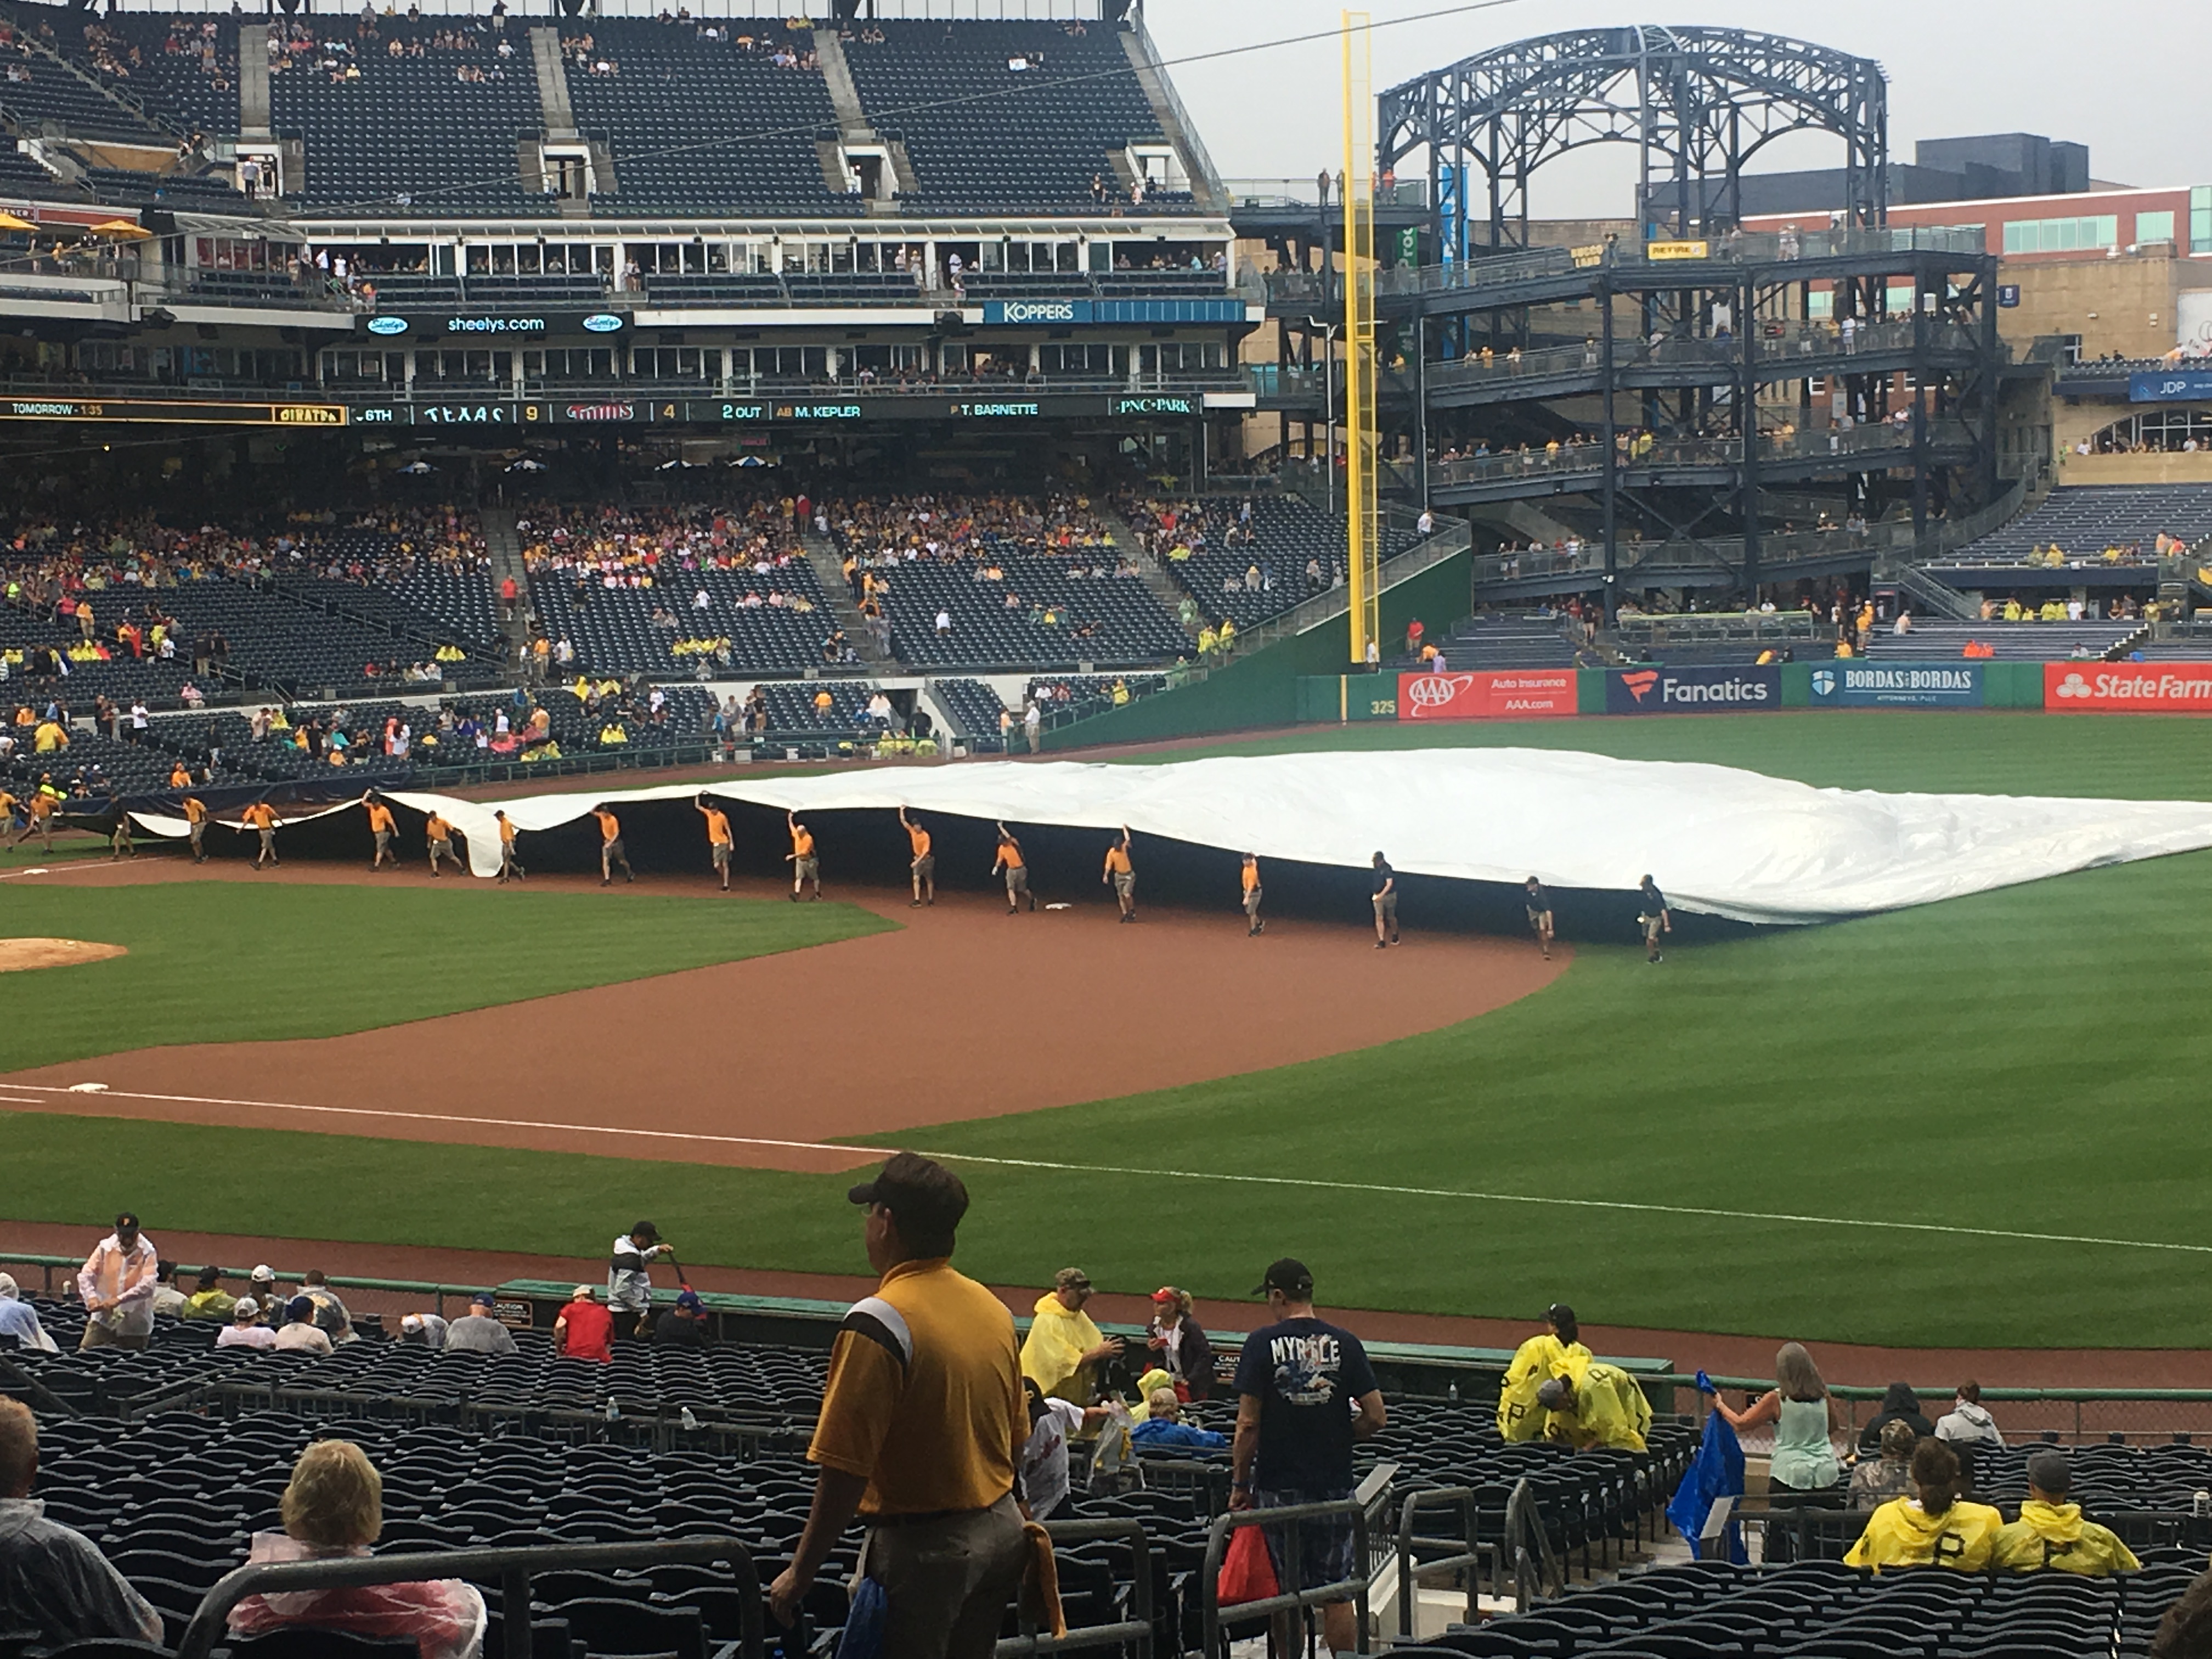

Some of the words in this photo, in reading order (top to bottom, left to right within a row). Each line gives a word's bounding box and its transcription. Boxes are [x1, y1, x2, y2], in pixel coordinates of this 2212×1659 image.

[1004, 302, 1074, 323] KOPPERS
[448, 317, 544, 332] sheelys.com
[2160, 381, 2186, 394] JDP
[12, 403, 73, 415] TOMORROW
[663, 405, 675, 419] 4
[723, 404, 733, 419] 2
[736, 407, 762, 418] OUT
[777, 407, 792, 417] AB
[795, 407, 811, 417] M.
[814, 406, 861, 417] KEPLER
[961, 405, 972, 415] T.
[974, 404, 1038, 415] BARNETTE
[1121, 399, 1151, 413] PNC
[1156, 398, 1190, 413] PARK
[365, 409, 392, 421] 6TH
[526, 406, 538, 421] 9
[1491, 679, 1516, 689] Auto
[1519, 678, 1566, 689] Insurance
[1846, 670, 1904, 688] BORDAS
[1910, 670, 1972, 689] BORDAS
[1414, 680, 1451, 703] AAA
[1663, 678, 1767, 703] Fanatics
[1372, 701, 1395, 714] 325
[1505, 699, 1554, 710] AAA.com
